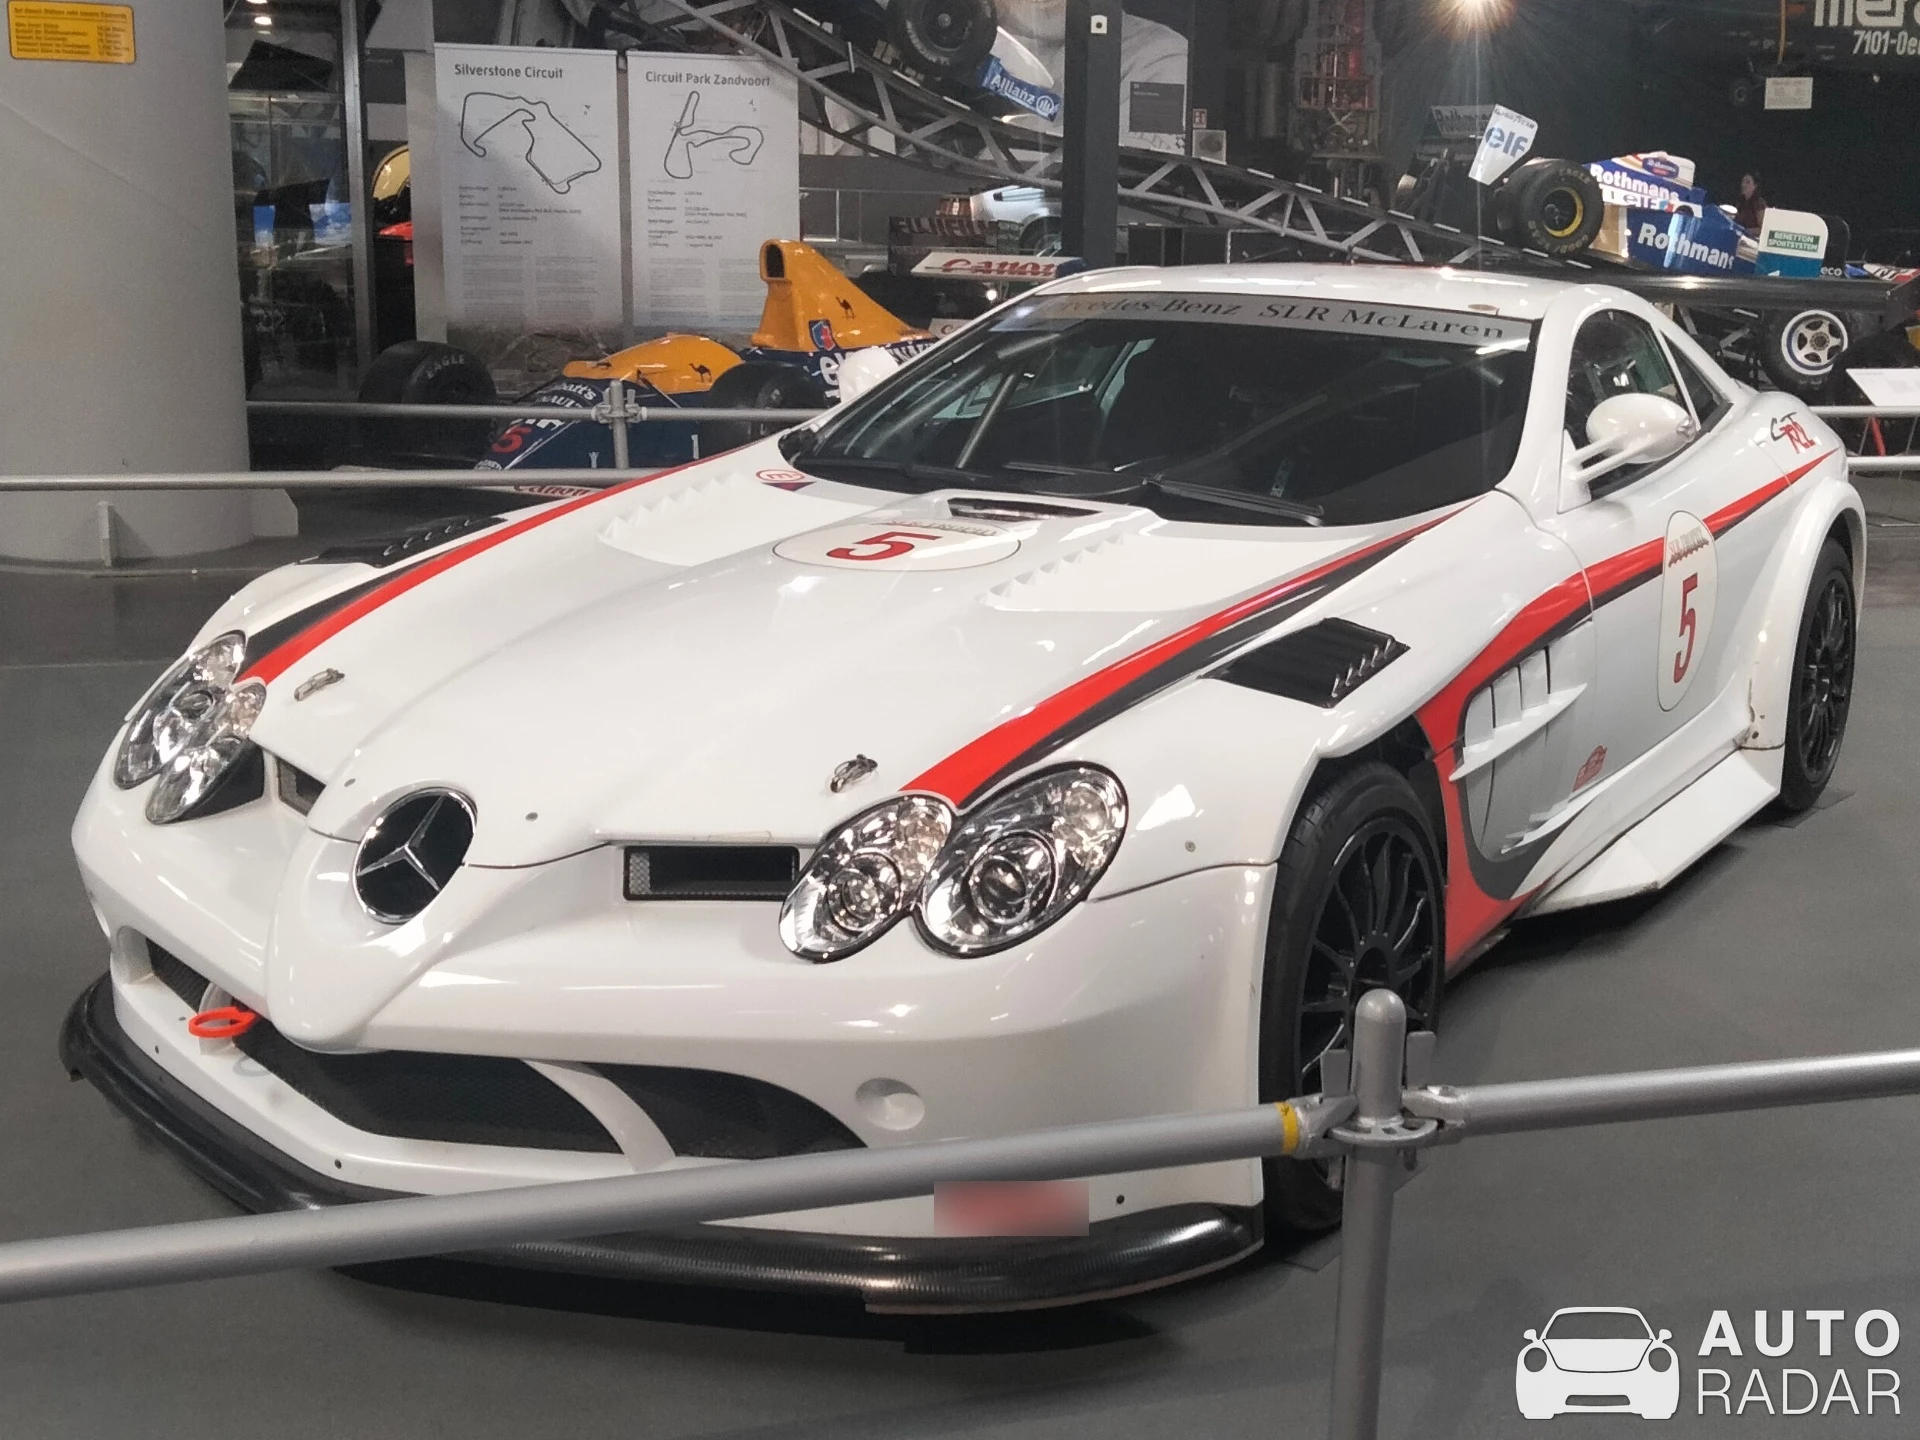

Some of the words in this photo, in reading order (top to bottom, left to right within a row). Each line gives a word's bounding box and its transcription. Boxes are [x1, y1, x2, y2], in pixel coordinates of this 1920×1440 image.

[454, 64, 520, 77] Silverstone
[523, 67, 562, 79] Circuit
[645, 71, 682, 83] Circuit
[685, 73, 710, 85] Park
[712, 74, 770, 87] Zandvoort
[991, 74, 1036, 105] Allianz
[1485, 127, 1527, 158] elf
[1590, 163, 1679, 203] Rothmans
[1637, 222, 1734, 270] Rothmans
[1768, 238, 1818, 251] SPORTSYSTEM
[1774, 231, 1813, 243] BENETTON
[1259, 304, 1329, 321] SLR
[1342, 308, 1504, 339] McLaren
[491, 423, 532, 454] 5
[826, 531, 942, 561] 5
[1673, 572, 1698, 684] 5
